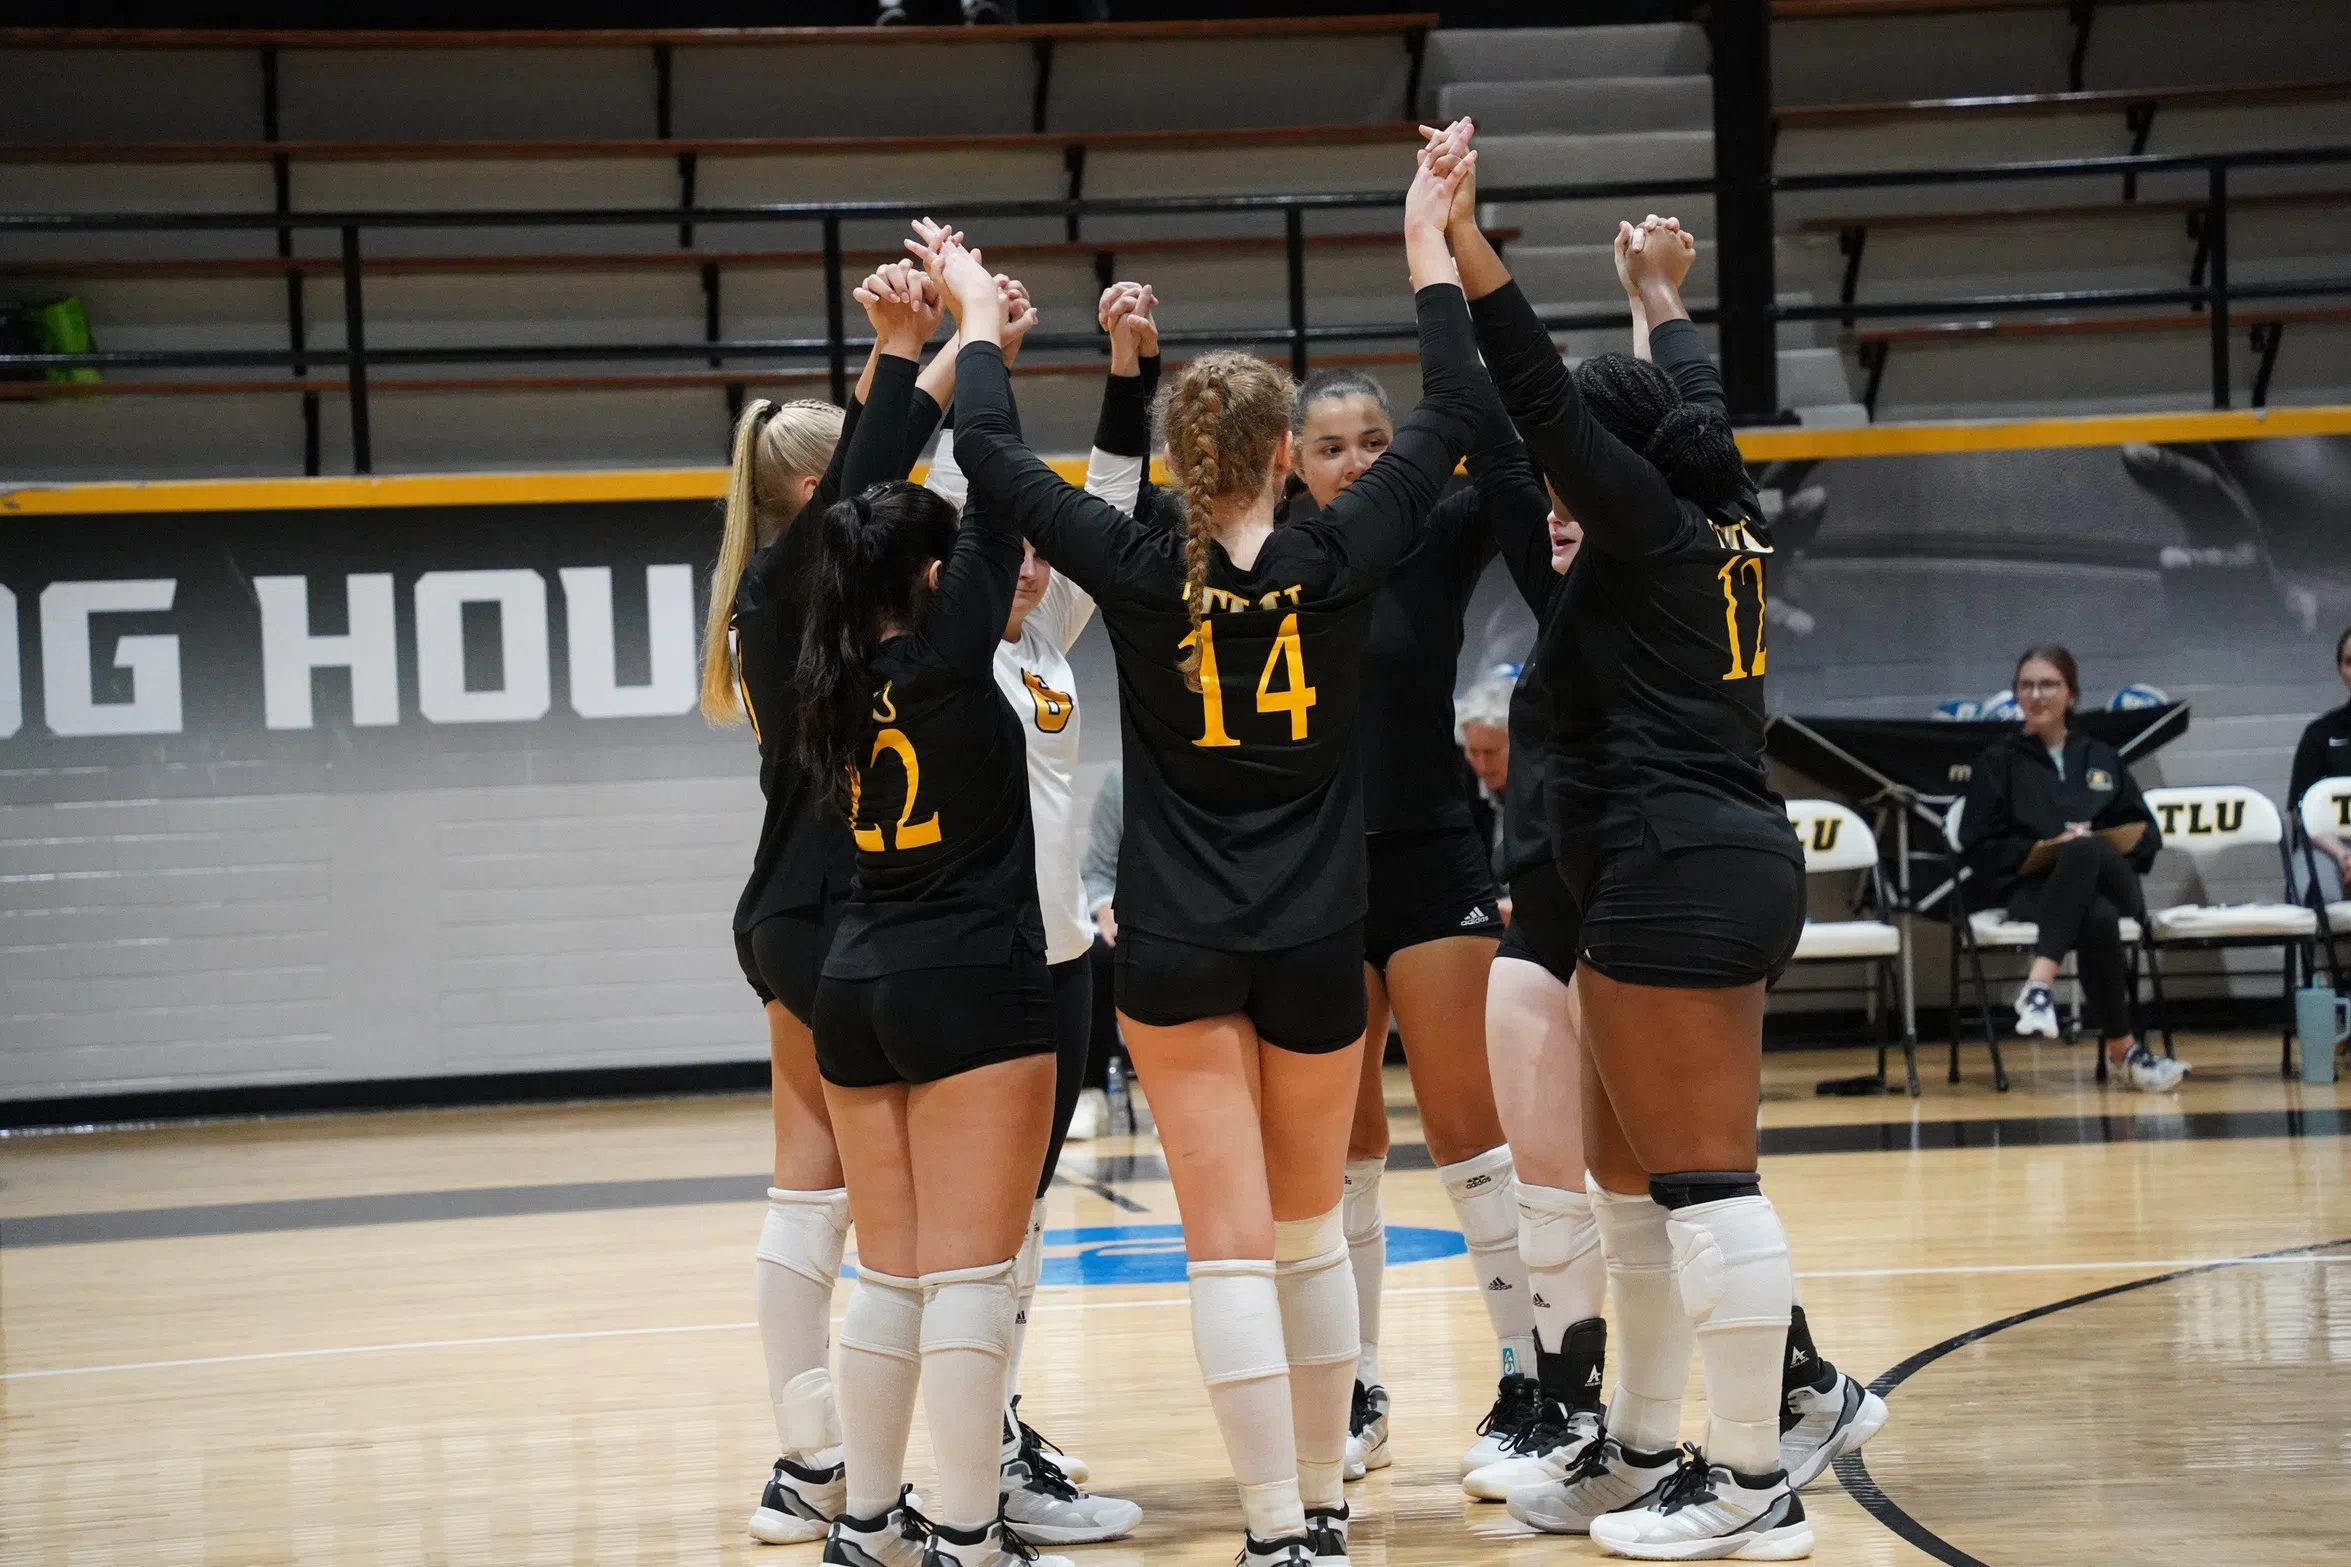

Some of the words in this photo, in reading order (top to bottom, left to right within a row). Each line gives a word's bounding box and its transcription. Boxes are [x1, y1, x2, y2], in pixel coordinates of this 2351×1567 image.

[0, 578, 183, 739] G
[1177, 613, 1317, 747] 14
[2156, 800, 2246, 835] TLU
[1460, 915, 1489, 927] adidas
[1466, 1176, 1492, 1189] adidas
